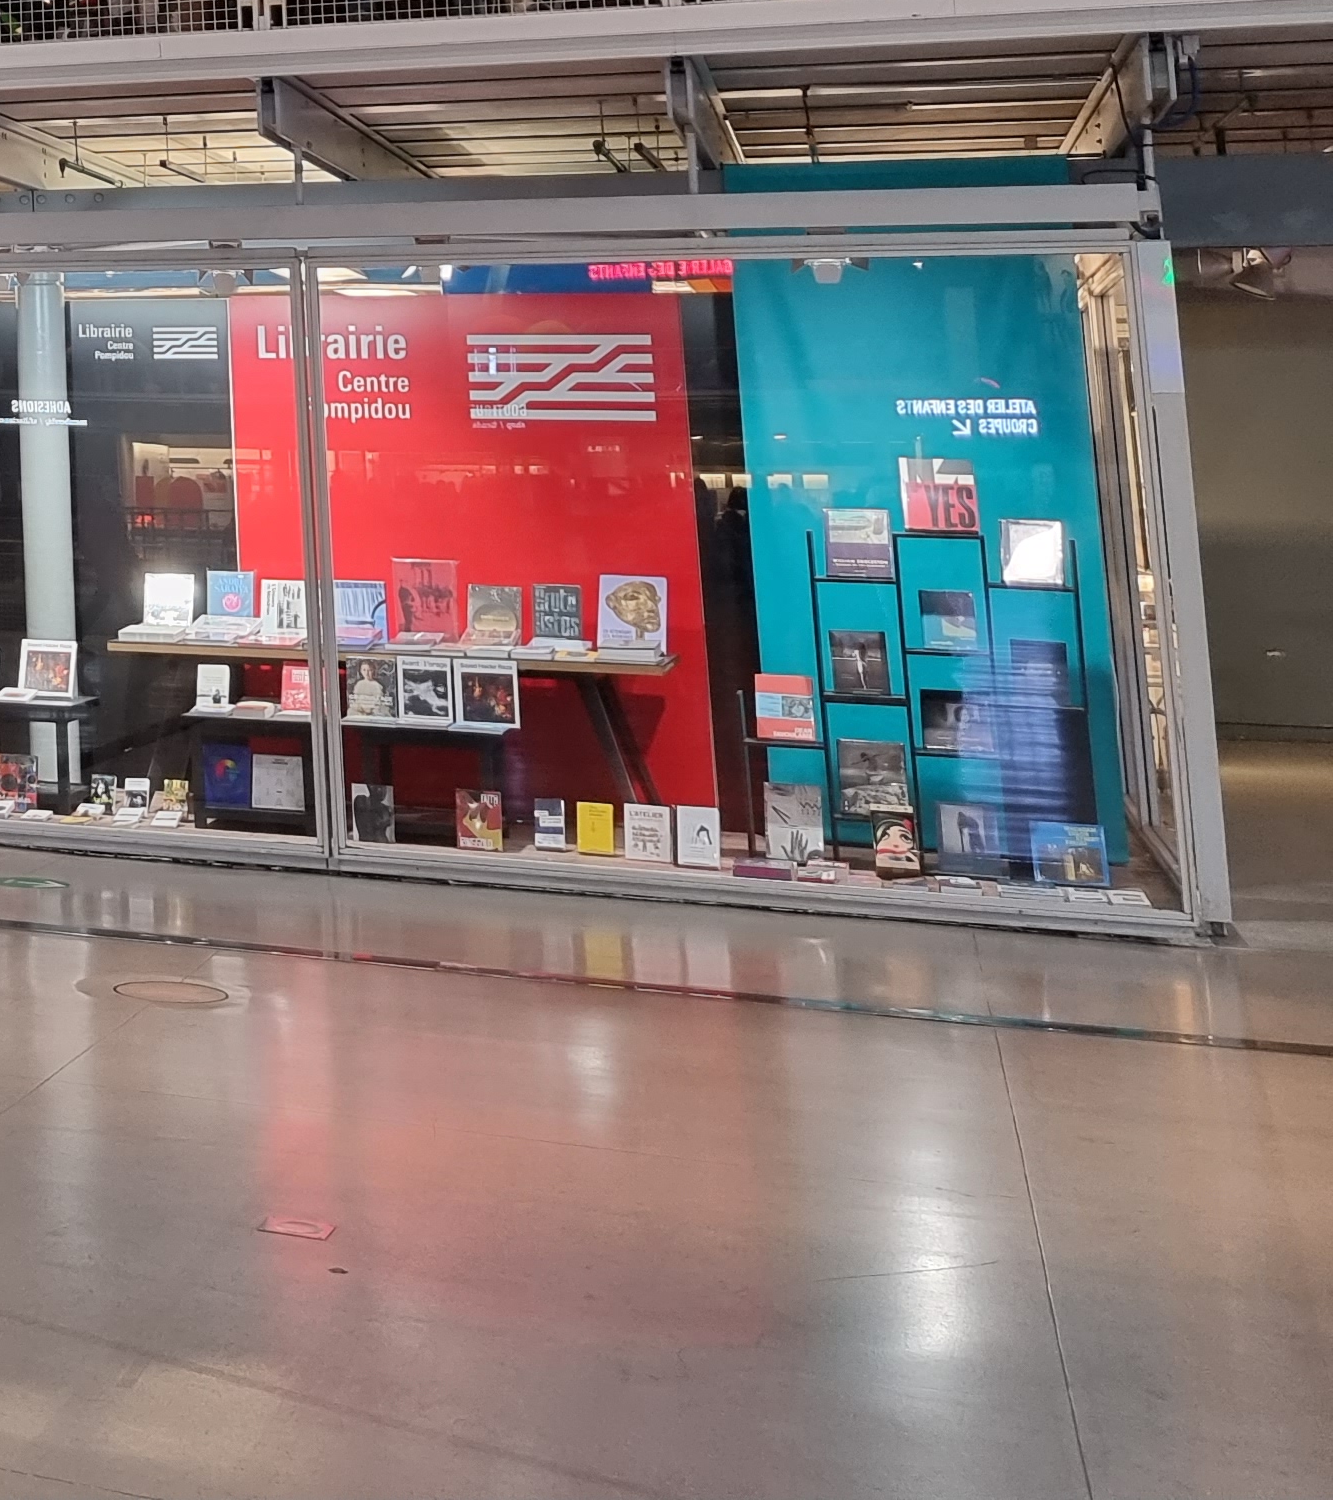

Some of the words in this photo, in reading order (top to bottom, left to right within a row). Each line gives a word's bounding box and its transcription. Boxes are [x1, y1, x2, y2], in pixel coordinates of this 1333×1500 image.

[78, 324, 133, 338] Librairie
[107, 340, 133, 350] Centre
[256, 325, 407, 360] Liairie
[94, 350, 134, 361] Pompidou
[337, 370, 410, 392] Centre
[924, 486, 977, 529] YES
